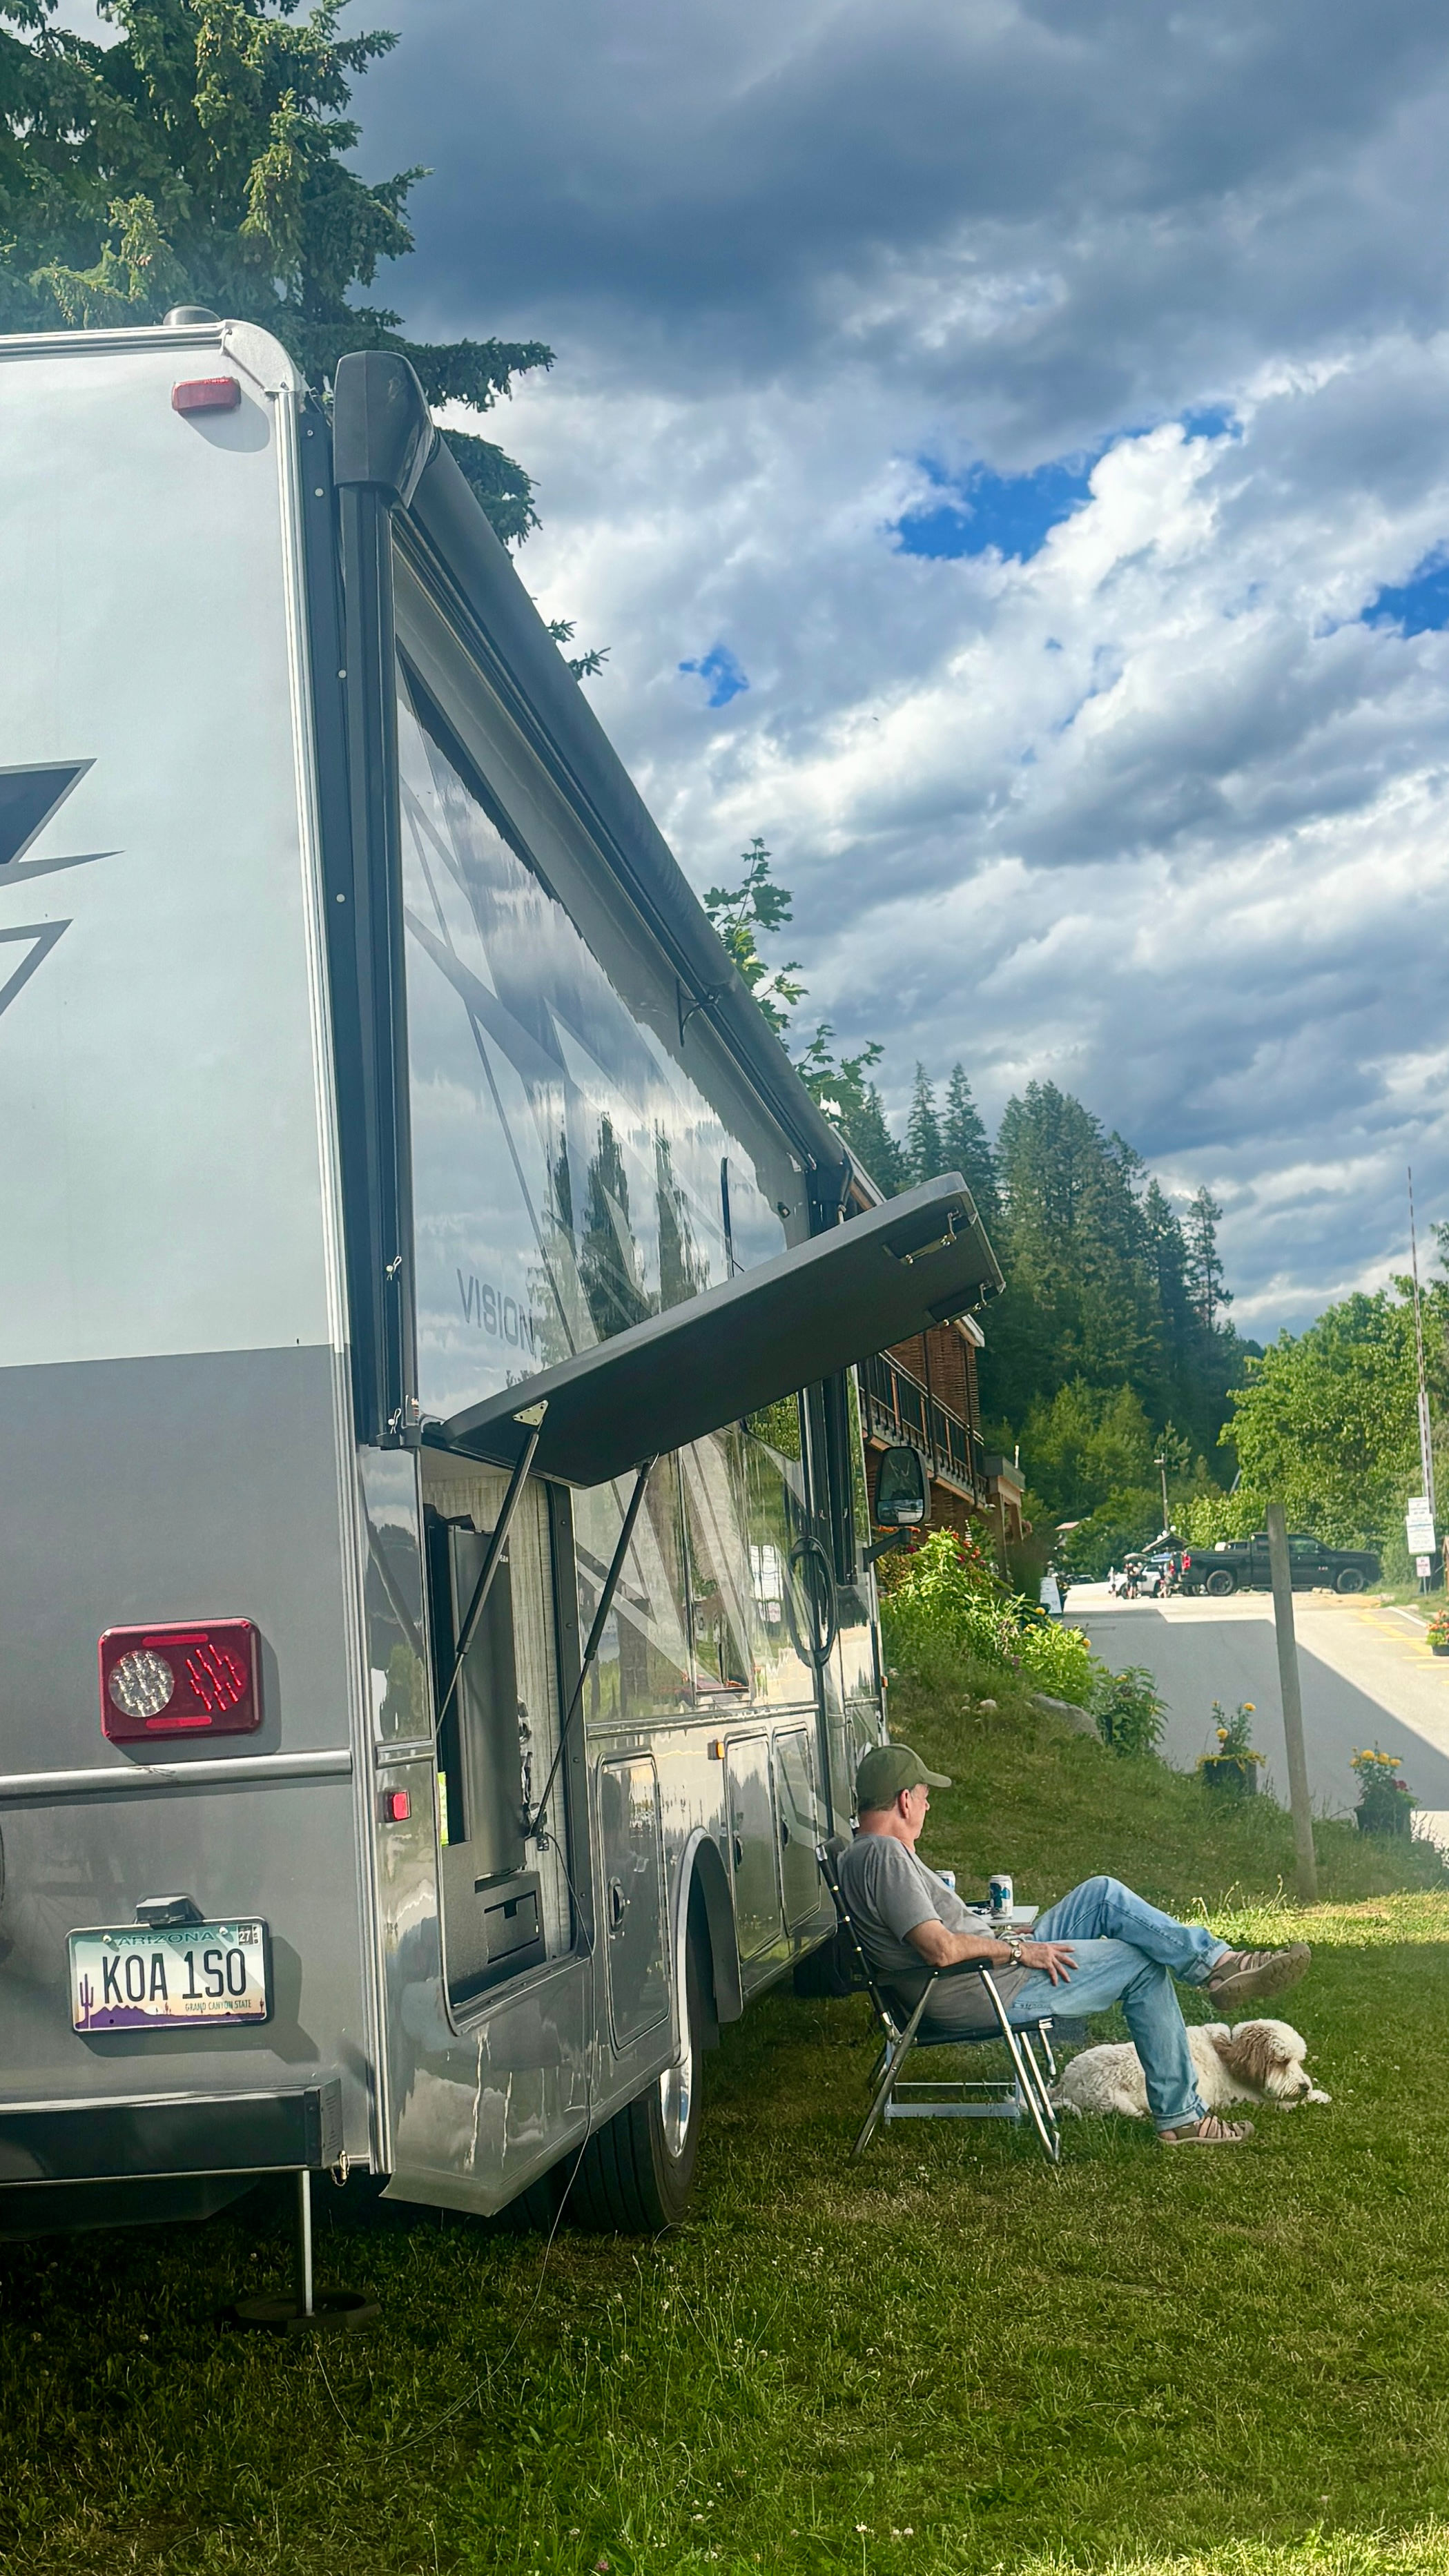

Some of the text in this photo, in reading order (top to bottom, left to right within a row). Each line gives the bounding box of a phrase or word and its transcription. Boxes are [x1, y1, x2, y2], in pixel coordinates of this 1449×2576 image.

[456, 1268, 535, 1356] VISION
[118, 1931, 215, 1946] ARIZONA
[238, 1930, 251, 1942] 27
[102, 1953, 168, 2004] KOA
[185, 1999, 251, 2011] GRAND CANYON STATE
